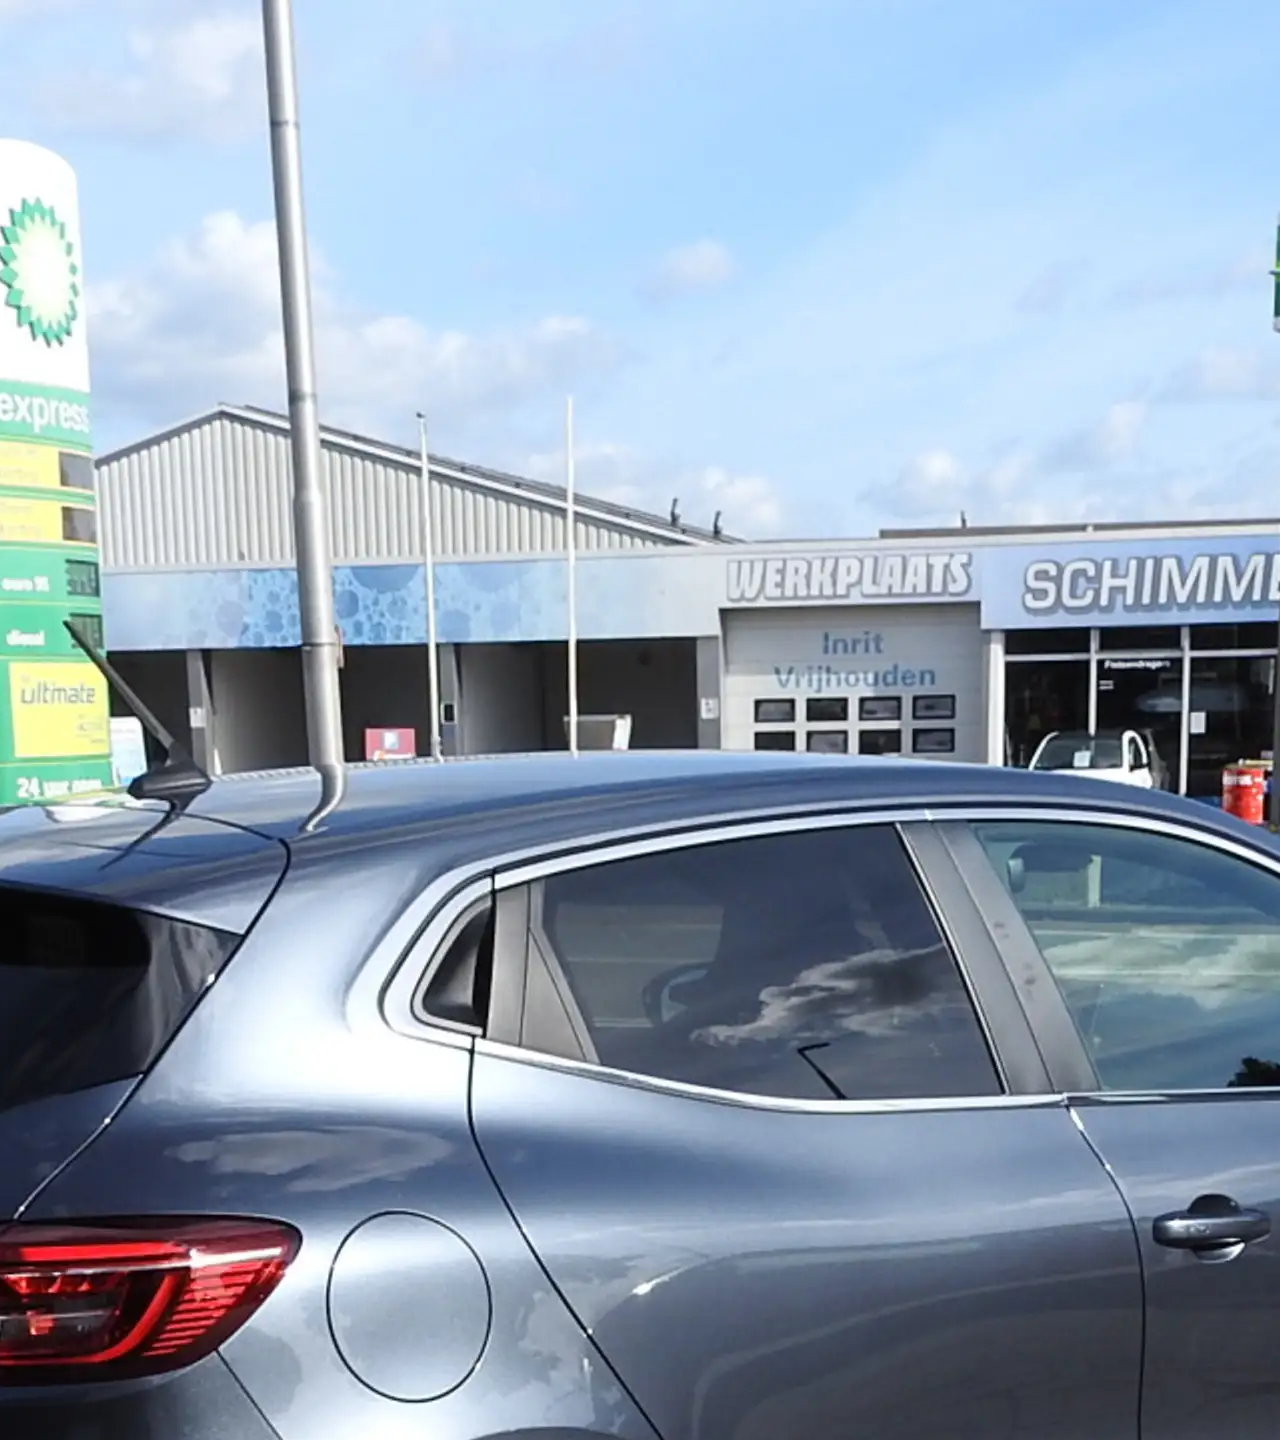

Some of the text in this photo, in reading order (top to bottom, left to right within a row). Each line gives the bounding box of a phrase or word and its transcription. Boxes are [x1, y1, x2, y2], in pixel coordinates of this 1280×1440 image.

[726, 553, 972, 601] WERKPLAATS
[822, 631, 885, 655] Inrit
[773, 663, 936, 693] Vrijhouden
[20, 681, 96, 705] ultimate
